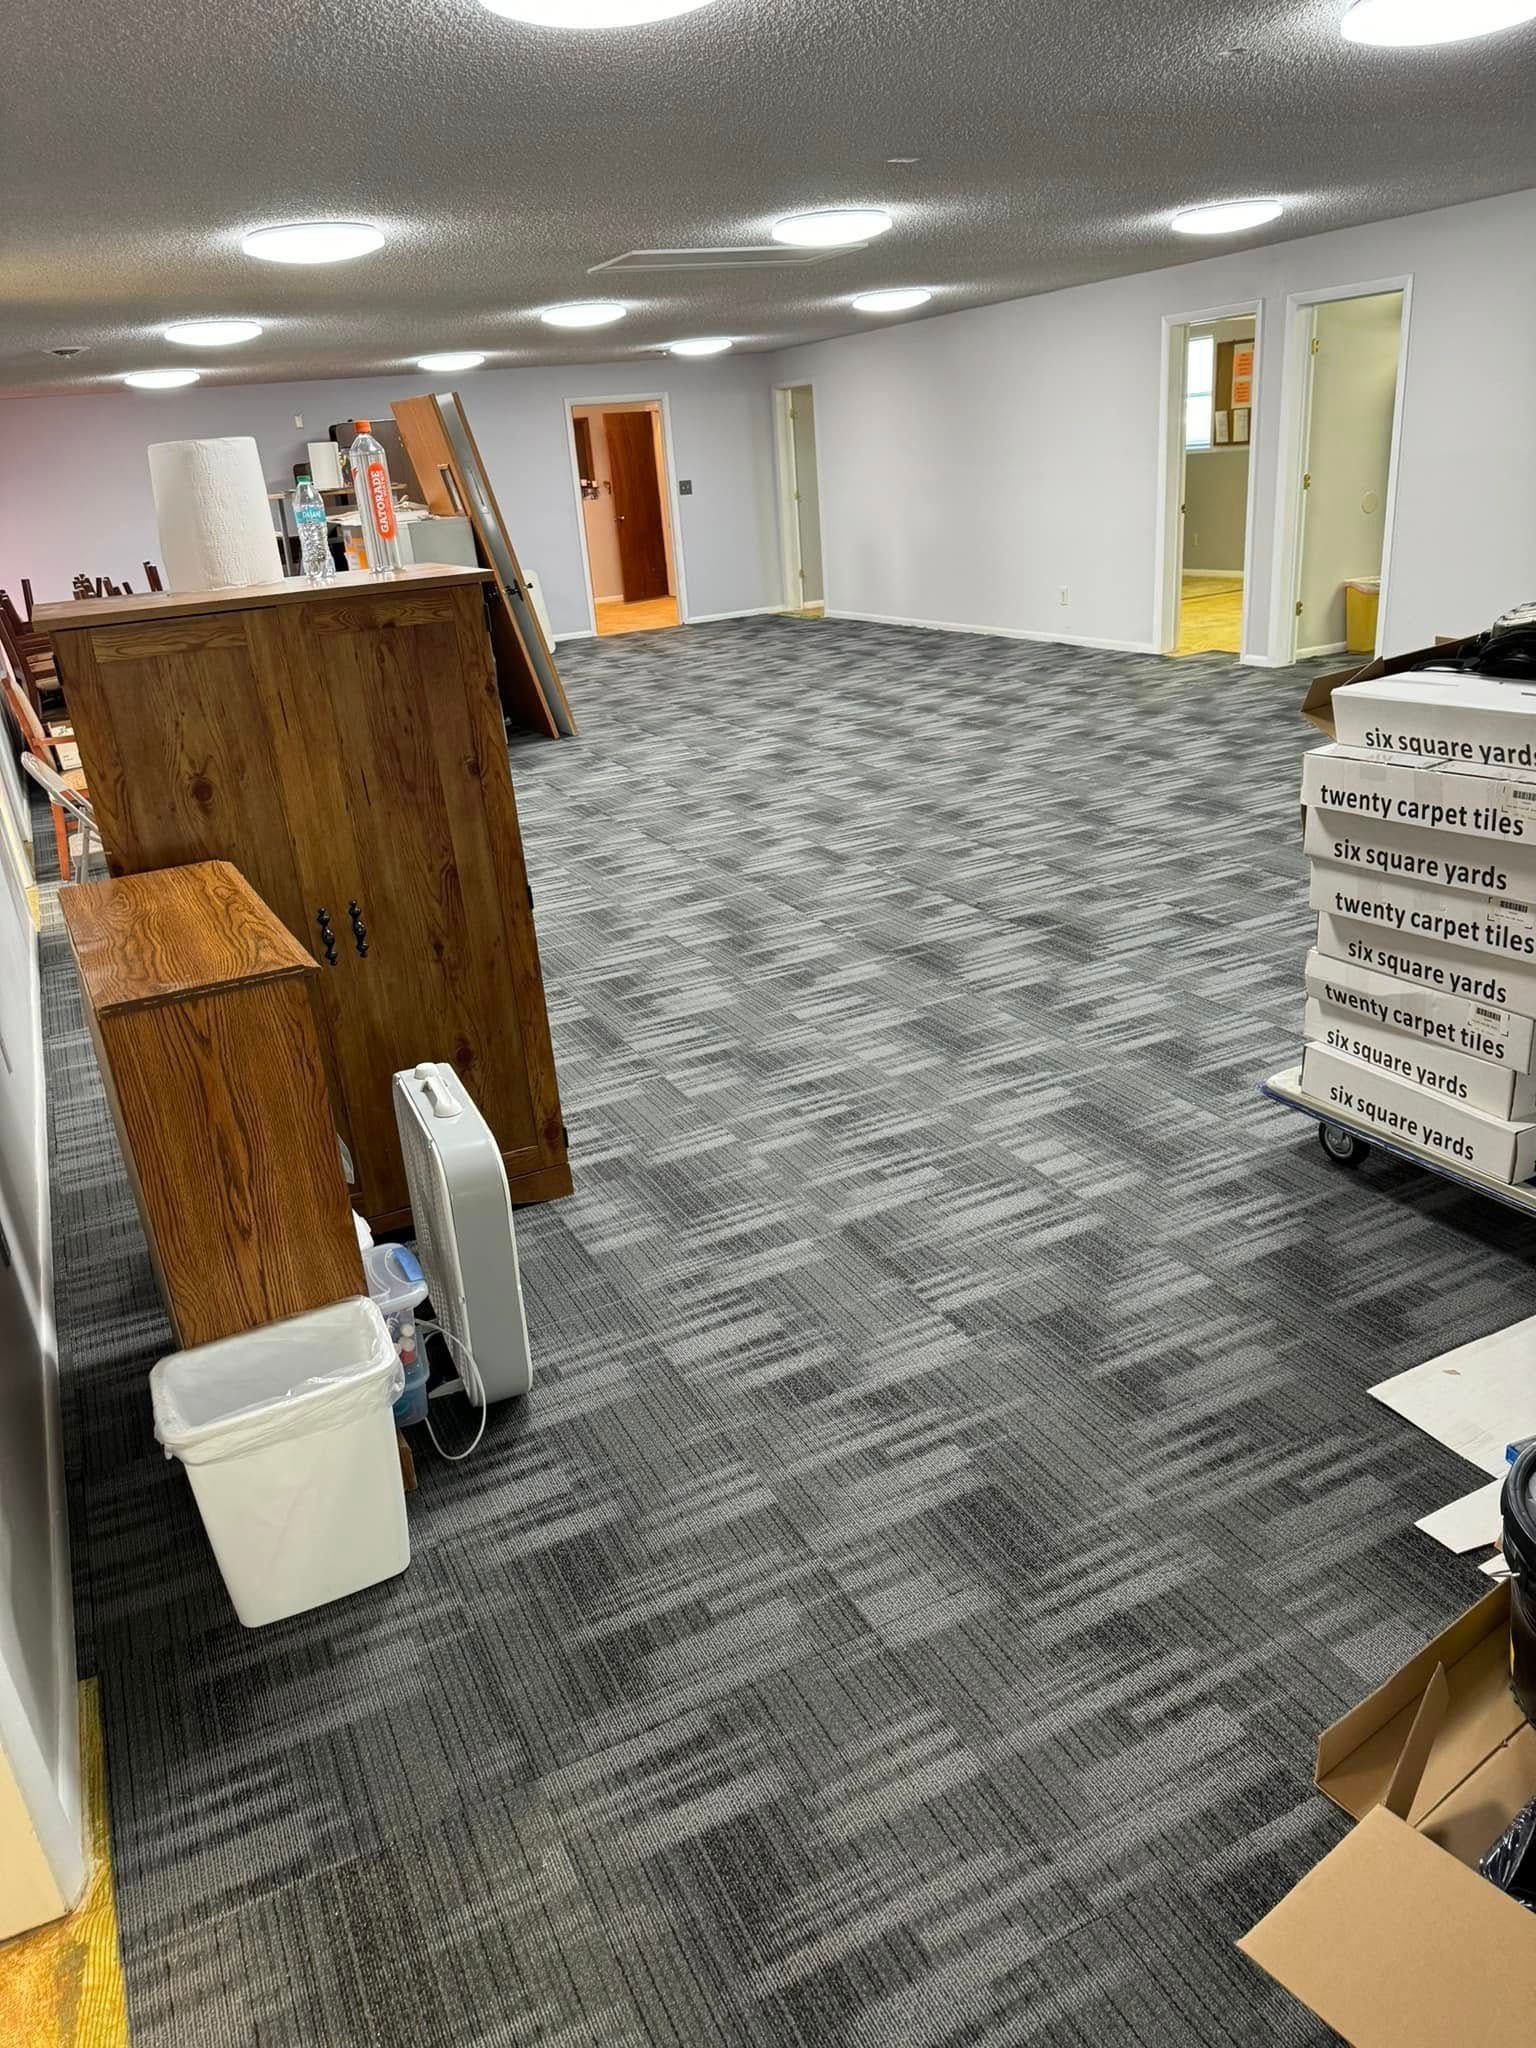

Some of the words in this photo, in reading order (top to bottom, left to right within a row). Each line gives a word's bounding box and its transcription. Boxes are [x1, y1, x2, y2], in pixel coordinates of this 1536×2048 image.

[370, 470, 390, 533] GATORADE
[1365, 727, 1394, 749] six
[1398, 735, 1473, 759] square
[1478, 743, 1536, 766] yard
[1320, 785, 1392, 819] twenty
[1397, 800, 1468, 827] carpet
[1473, 807, 1524, 836] tiles
[1334, 838, 1361, 862] six
[1366, 848, 1439, 877] square
[1444, 865, 1507, 890] yards
[1335, 892, 1406, 929] twenty
[1410, 912, 1480, 940] carpet
[1485, 924, 1535, 954] tiles
[1348, 940, 1373, 963] six
[1377, 951, 1444, 984] square
[1449, 972, 1507, 1003] yards
[1325, 983, 1389, 1022] twenty
[1393, 1009, 1456, 1043] carpet
[1460, 1028, 1505, 1059] tiles
[1327, 1029, 1349, 1051] six
[1353, 1041, 1412, 1076] square
[1416, 1066, 1468, 1098] yards
[1330, 1085, 1353, 1108] six
[1357, 1098, 1418, 1136] square
[1422, 1126, 1475, 1161] yards
